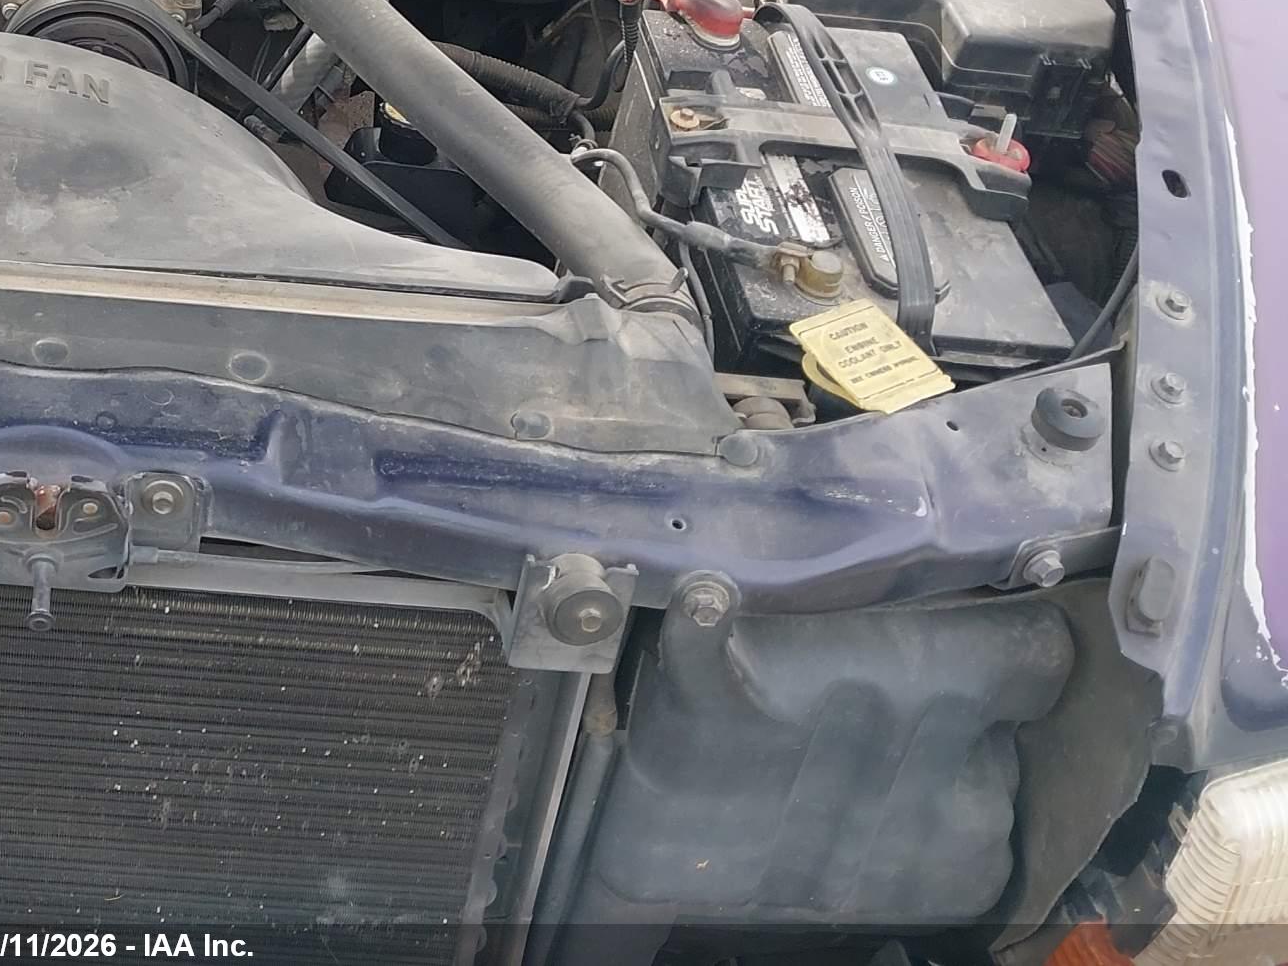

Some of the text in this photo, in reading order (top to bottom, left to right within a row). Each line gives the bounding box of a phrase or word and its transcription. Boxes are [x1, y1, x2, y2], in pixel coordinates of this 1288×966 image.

[23, 60, 113, 105] FAN
[829, 322, 868, 340] CAUTION
[838, 348, 877, 368] COOLANT
